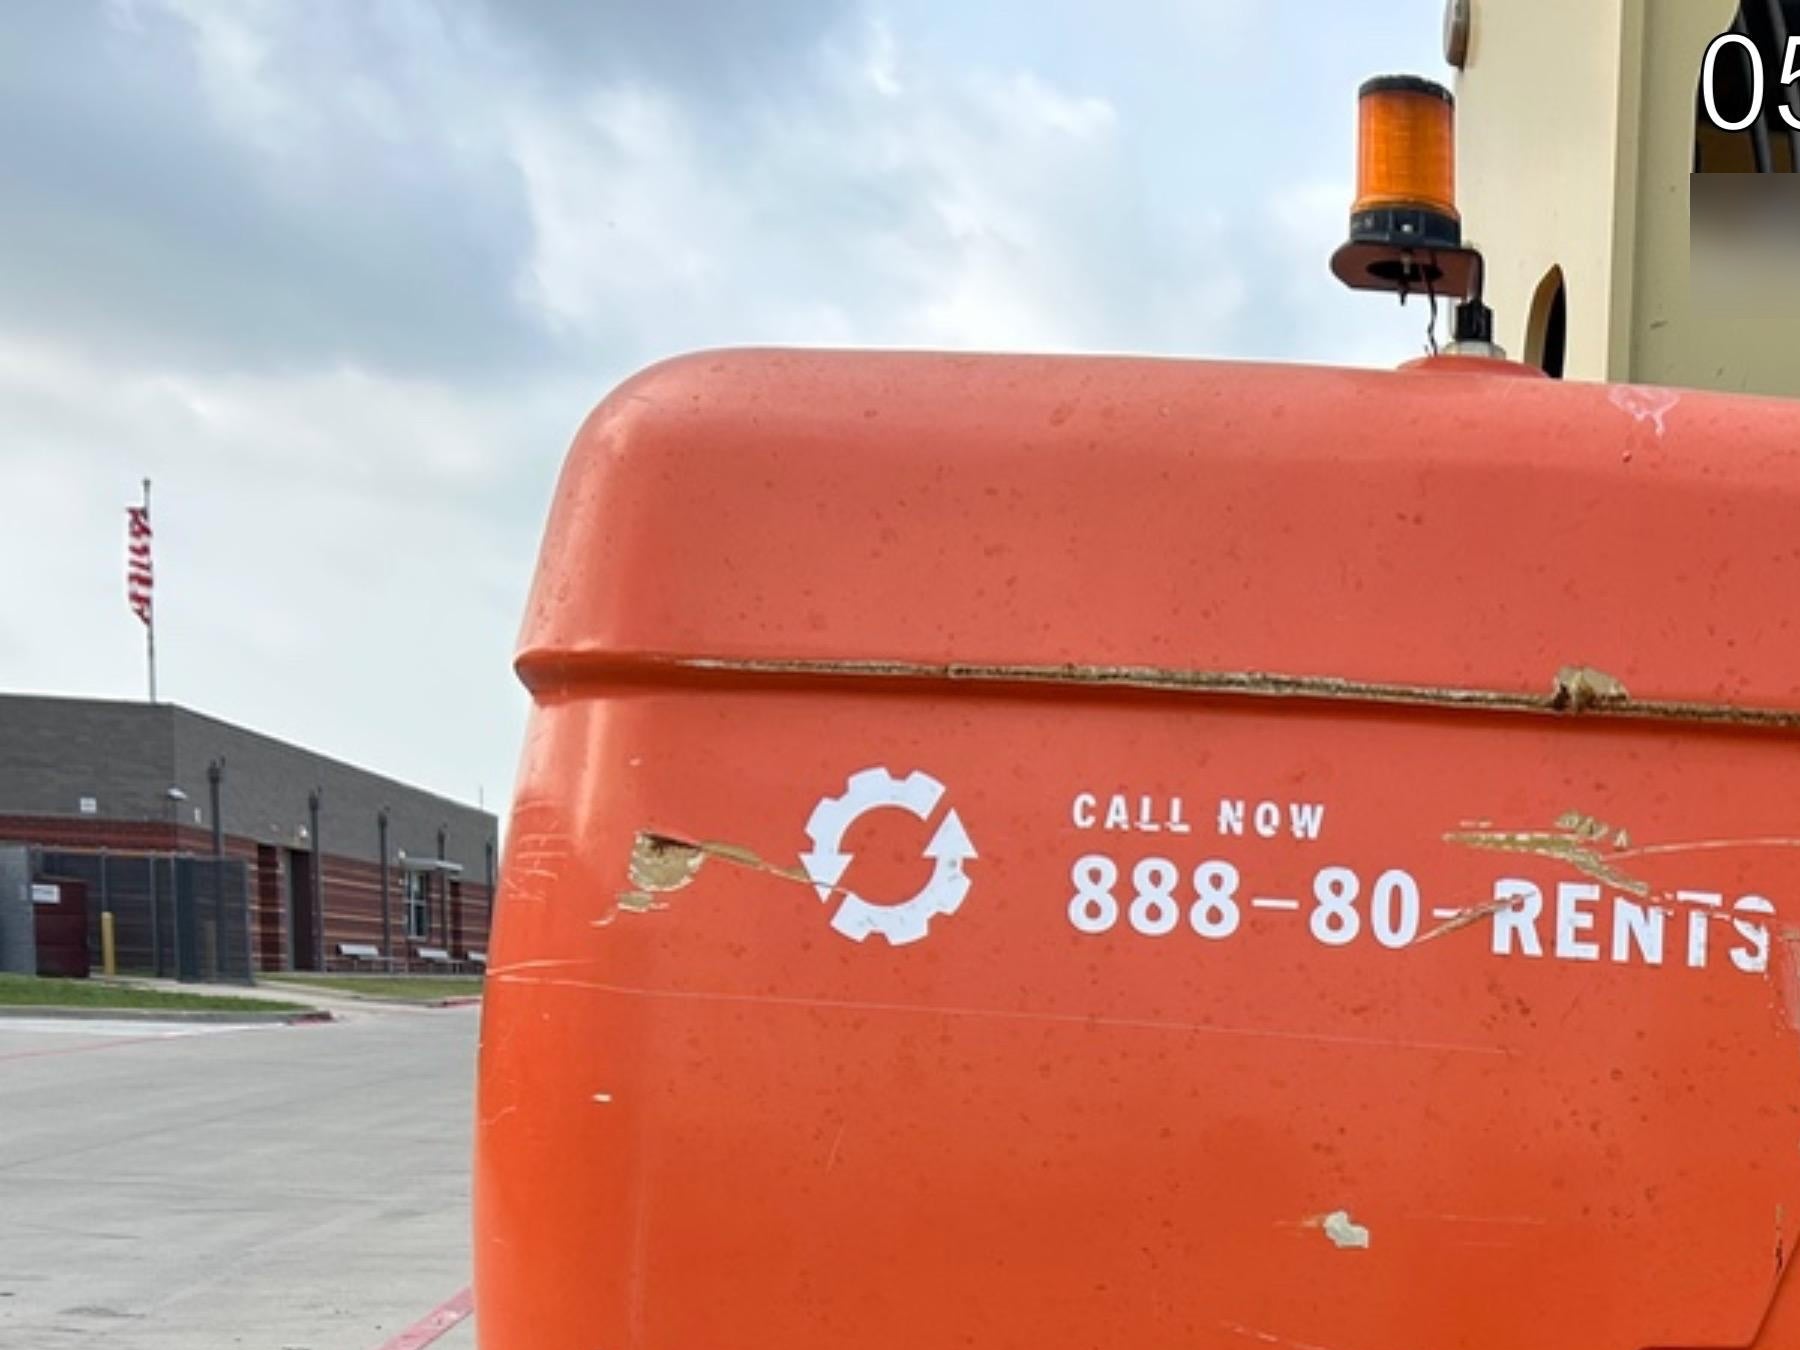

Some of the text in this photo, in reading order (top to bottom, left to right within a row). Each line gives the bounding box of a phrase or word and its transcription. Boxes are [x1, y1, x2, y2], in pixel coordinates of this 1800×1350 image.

[1073, 794, 1325, 840] CALL NOW
[1068, 855, 1776, 974] 888-80-RENTS
